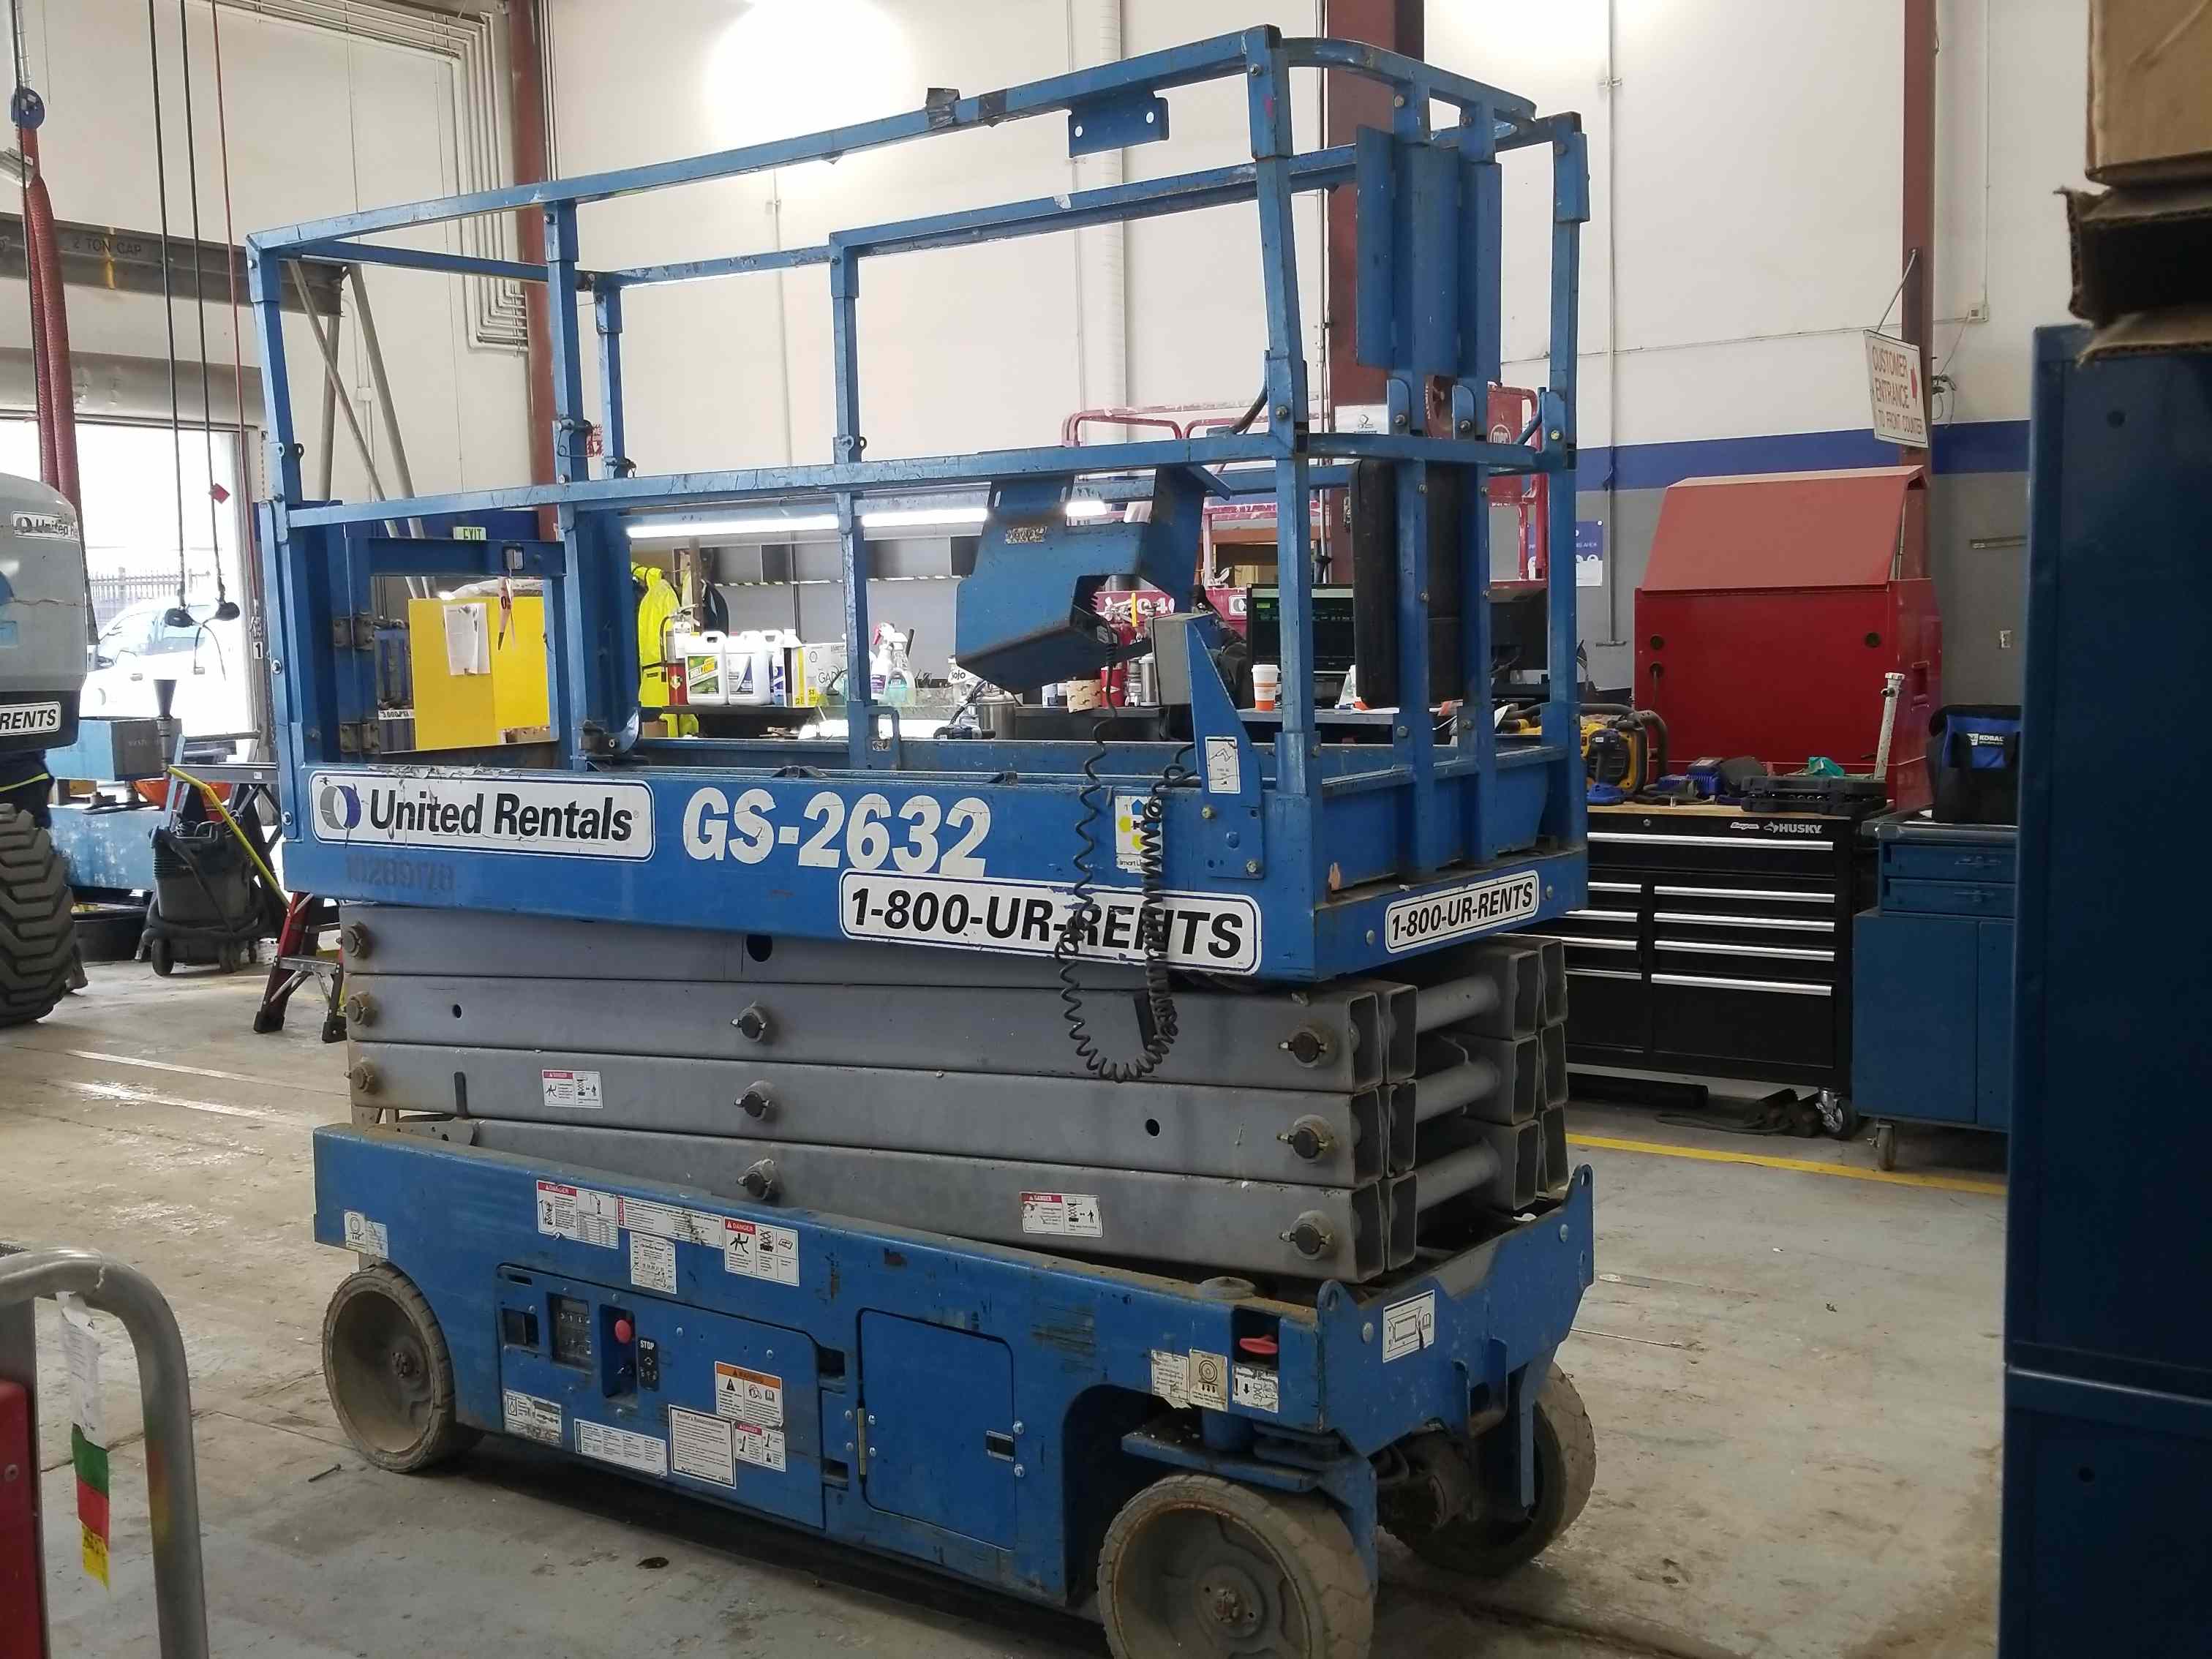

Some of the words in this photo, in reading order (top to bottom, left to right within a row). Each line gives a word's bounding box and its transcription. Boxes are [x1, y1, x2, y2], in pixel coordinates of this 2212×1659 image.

[117, 242, 141, 255] CAP
[1873, 346, 1908, 377] CUSTOMER
[1875, 377, 1910, 409] ENTRANCE
[463, 528, 481, 540] EXIT
[0, 709, 56, 730] RENTS
[370, 789, 484, 834] United
[494, 793, 633, 841] Rentals
[682, 787, 992, 877] GS-2632
[1779, 823, 1823, 834] HUSKY
[851, 887, 1243, 958] 1-800-UR-RENTS
[1392, 882, 1532, 940] 1-800-UR-RENTS
[732, 1222, 753, 1232] DANGER
[640, 1340, 655, 1350] STOP
